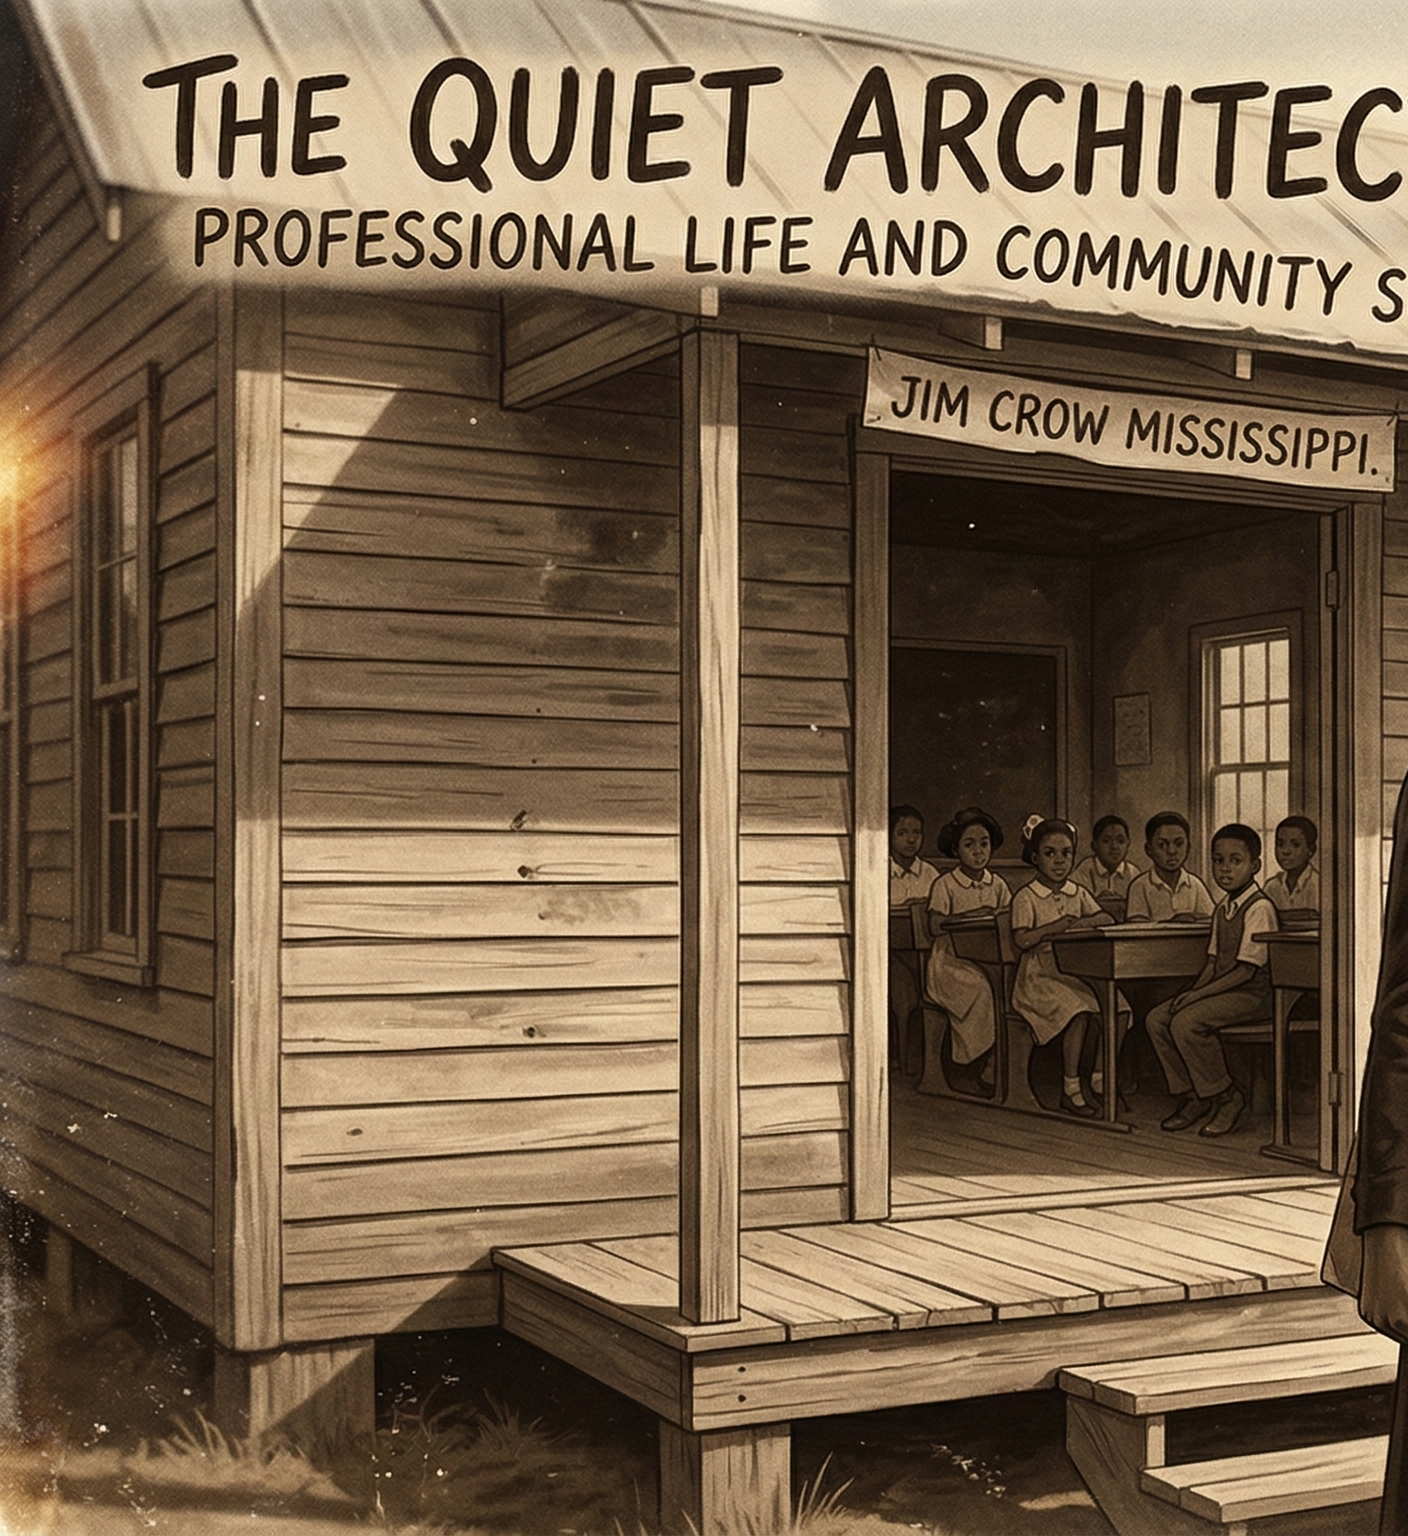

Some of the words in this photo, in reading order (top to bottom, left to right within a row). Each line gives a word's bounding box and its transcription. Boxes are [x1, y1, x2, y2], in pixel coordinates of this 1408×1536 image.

[890, 376, 970, 428] JIM
[988, 390, 1110, 446] CROW
[1125, 408, 1379, 476] MISSISSIPPI.
